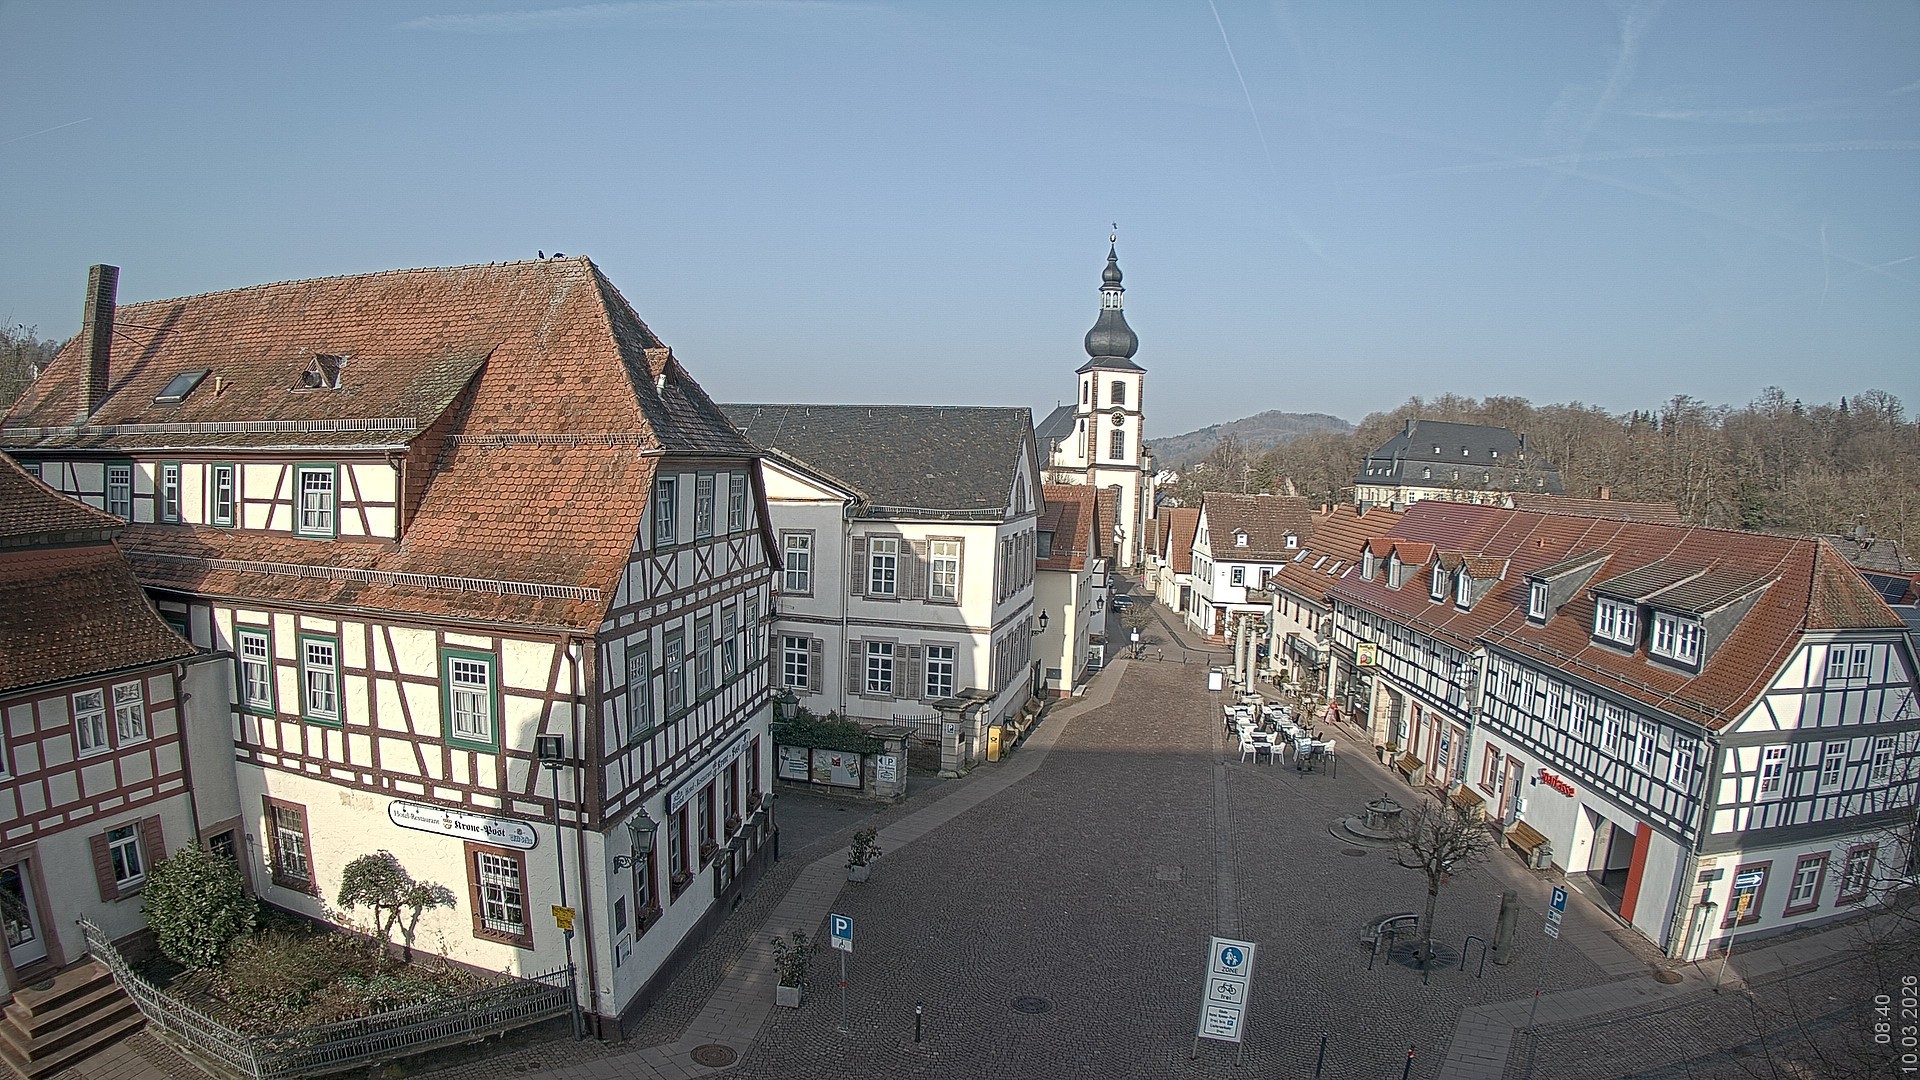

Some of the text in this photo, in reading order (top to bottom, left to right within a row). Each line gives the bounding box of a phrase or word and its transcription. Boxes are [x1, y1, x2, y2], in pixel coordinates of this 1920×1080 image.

[454, 820, 506, 837] Krone-Post
[1553, 890, 1564, 906] P
[836, 918, 848, 935] P
[1221, 966, 1239, 974] ZONE
[1220, 993, 1232, 1001] frei
